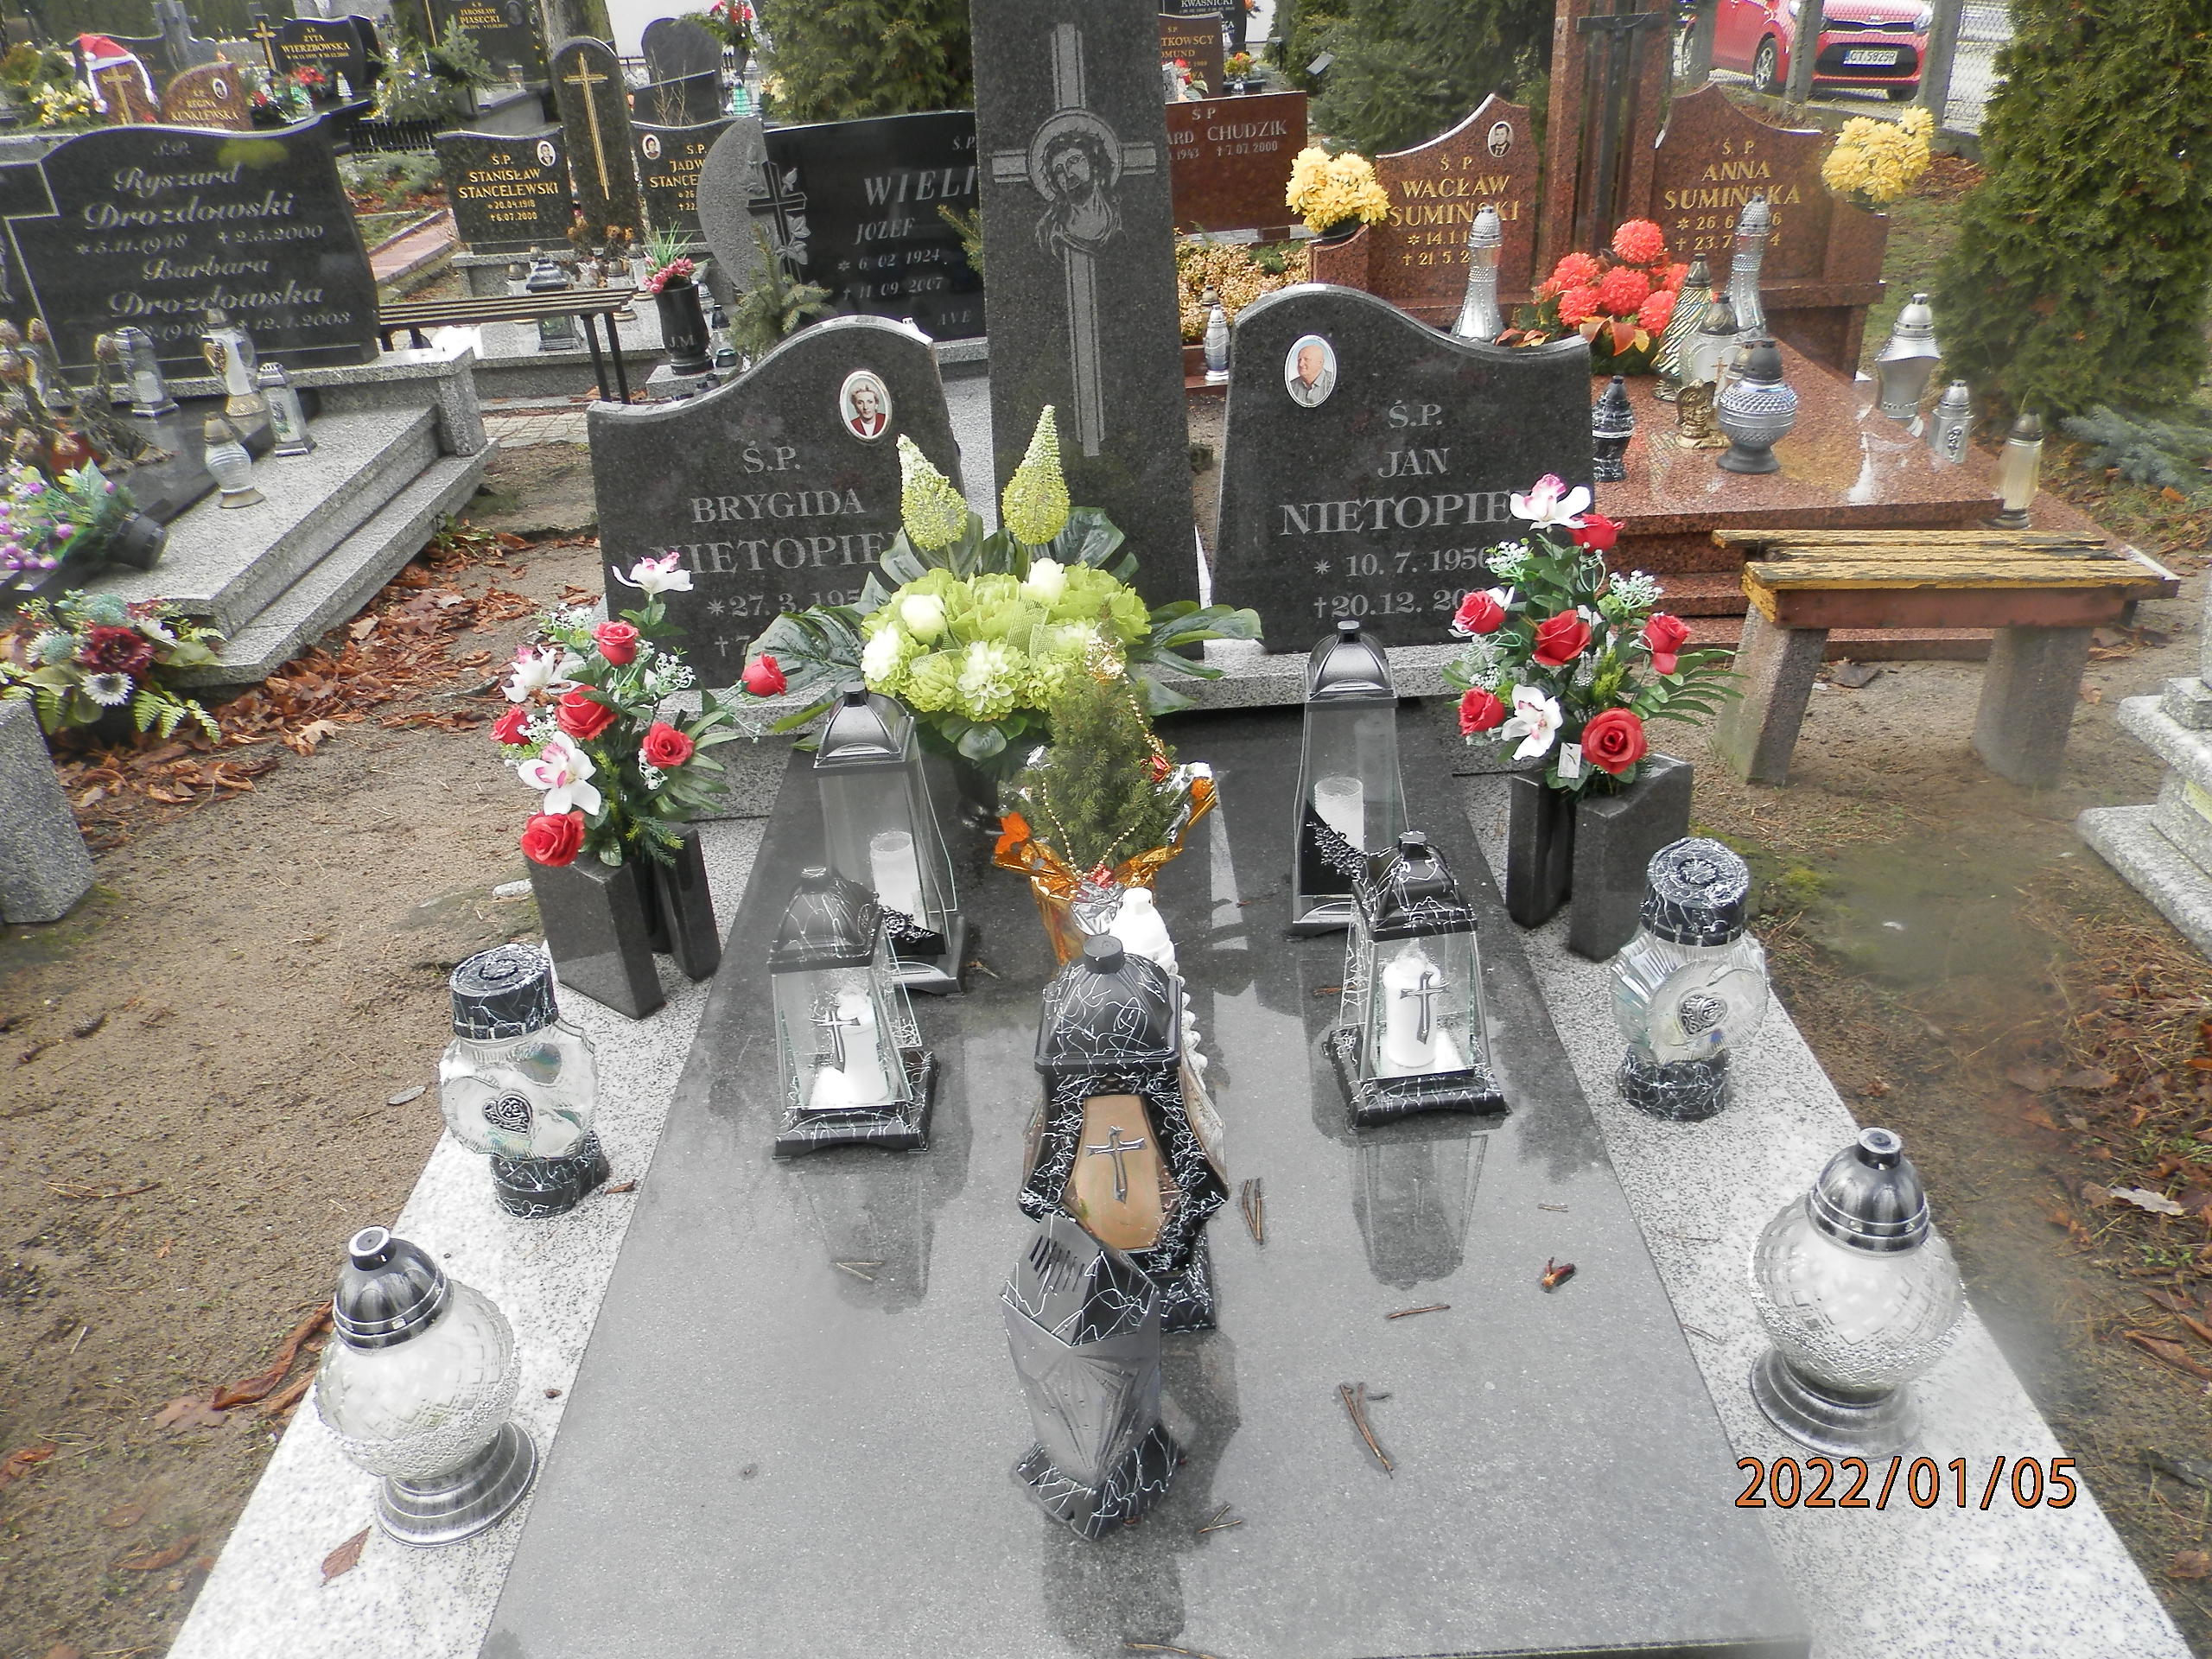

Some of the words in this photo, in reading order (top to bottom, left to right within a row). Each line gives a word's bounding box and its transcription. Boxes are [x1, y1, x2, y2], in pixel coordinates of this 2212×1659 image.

[459, 16, 500, 24] PIASECKI
[281, 41, 351, 53] WIERZBOWSKA
[1161, 35, 1214, 47] TKOWSCY
[1208, 119, 1287, 141] CHUDZIK
[469, 168, 541, 183] STANISŁAW
[669, 159, 706, 173] JADW
[1701, 161, 1770, 181] ANNA
[113, 161, 242, 198] Ryszard
[457, 181, 559, 199] STANCELEWSKI
[650, 174, 702, 188] STANCE
[864, 165, 976, 206] WIELI
[1402, 175, 1510, 199] WACŁAW
[84, 190, 295, 230] Drozdowski
[1389, 200, 1520, 227] SUMIŃKI
[1427, 230, 1469, 245] 14.1.1
[142, 255, 270, 281] Barbara
[907, 248, 940, 264] 1924
[908, 276, 944, 293] 2007
[109, 279, 323, 318] Drozdowska
[938, 310, 971, 326] AVE
[1388, 399, 1443, 429] Ś.P.
[742, 440, 801, 474] Ś.P.
[1377, 447, 1451, 478] JAN
[690, 487, 867, 524] BRYGIDA
[1279, 488, 1534, 537] NIETOPIE
[650, 531, 897, 575] IETOPIE
[1345, 553, 1384, 577] 10.
[1395, 550, 1417, 574] 7.
[729, 596, 771, 617] 27.
[810, 589, 861, 607] 195
